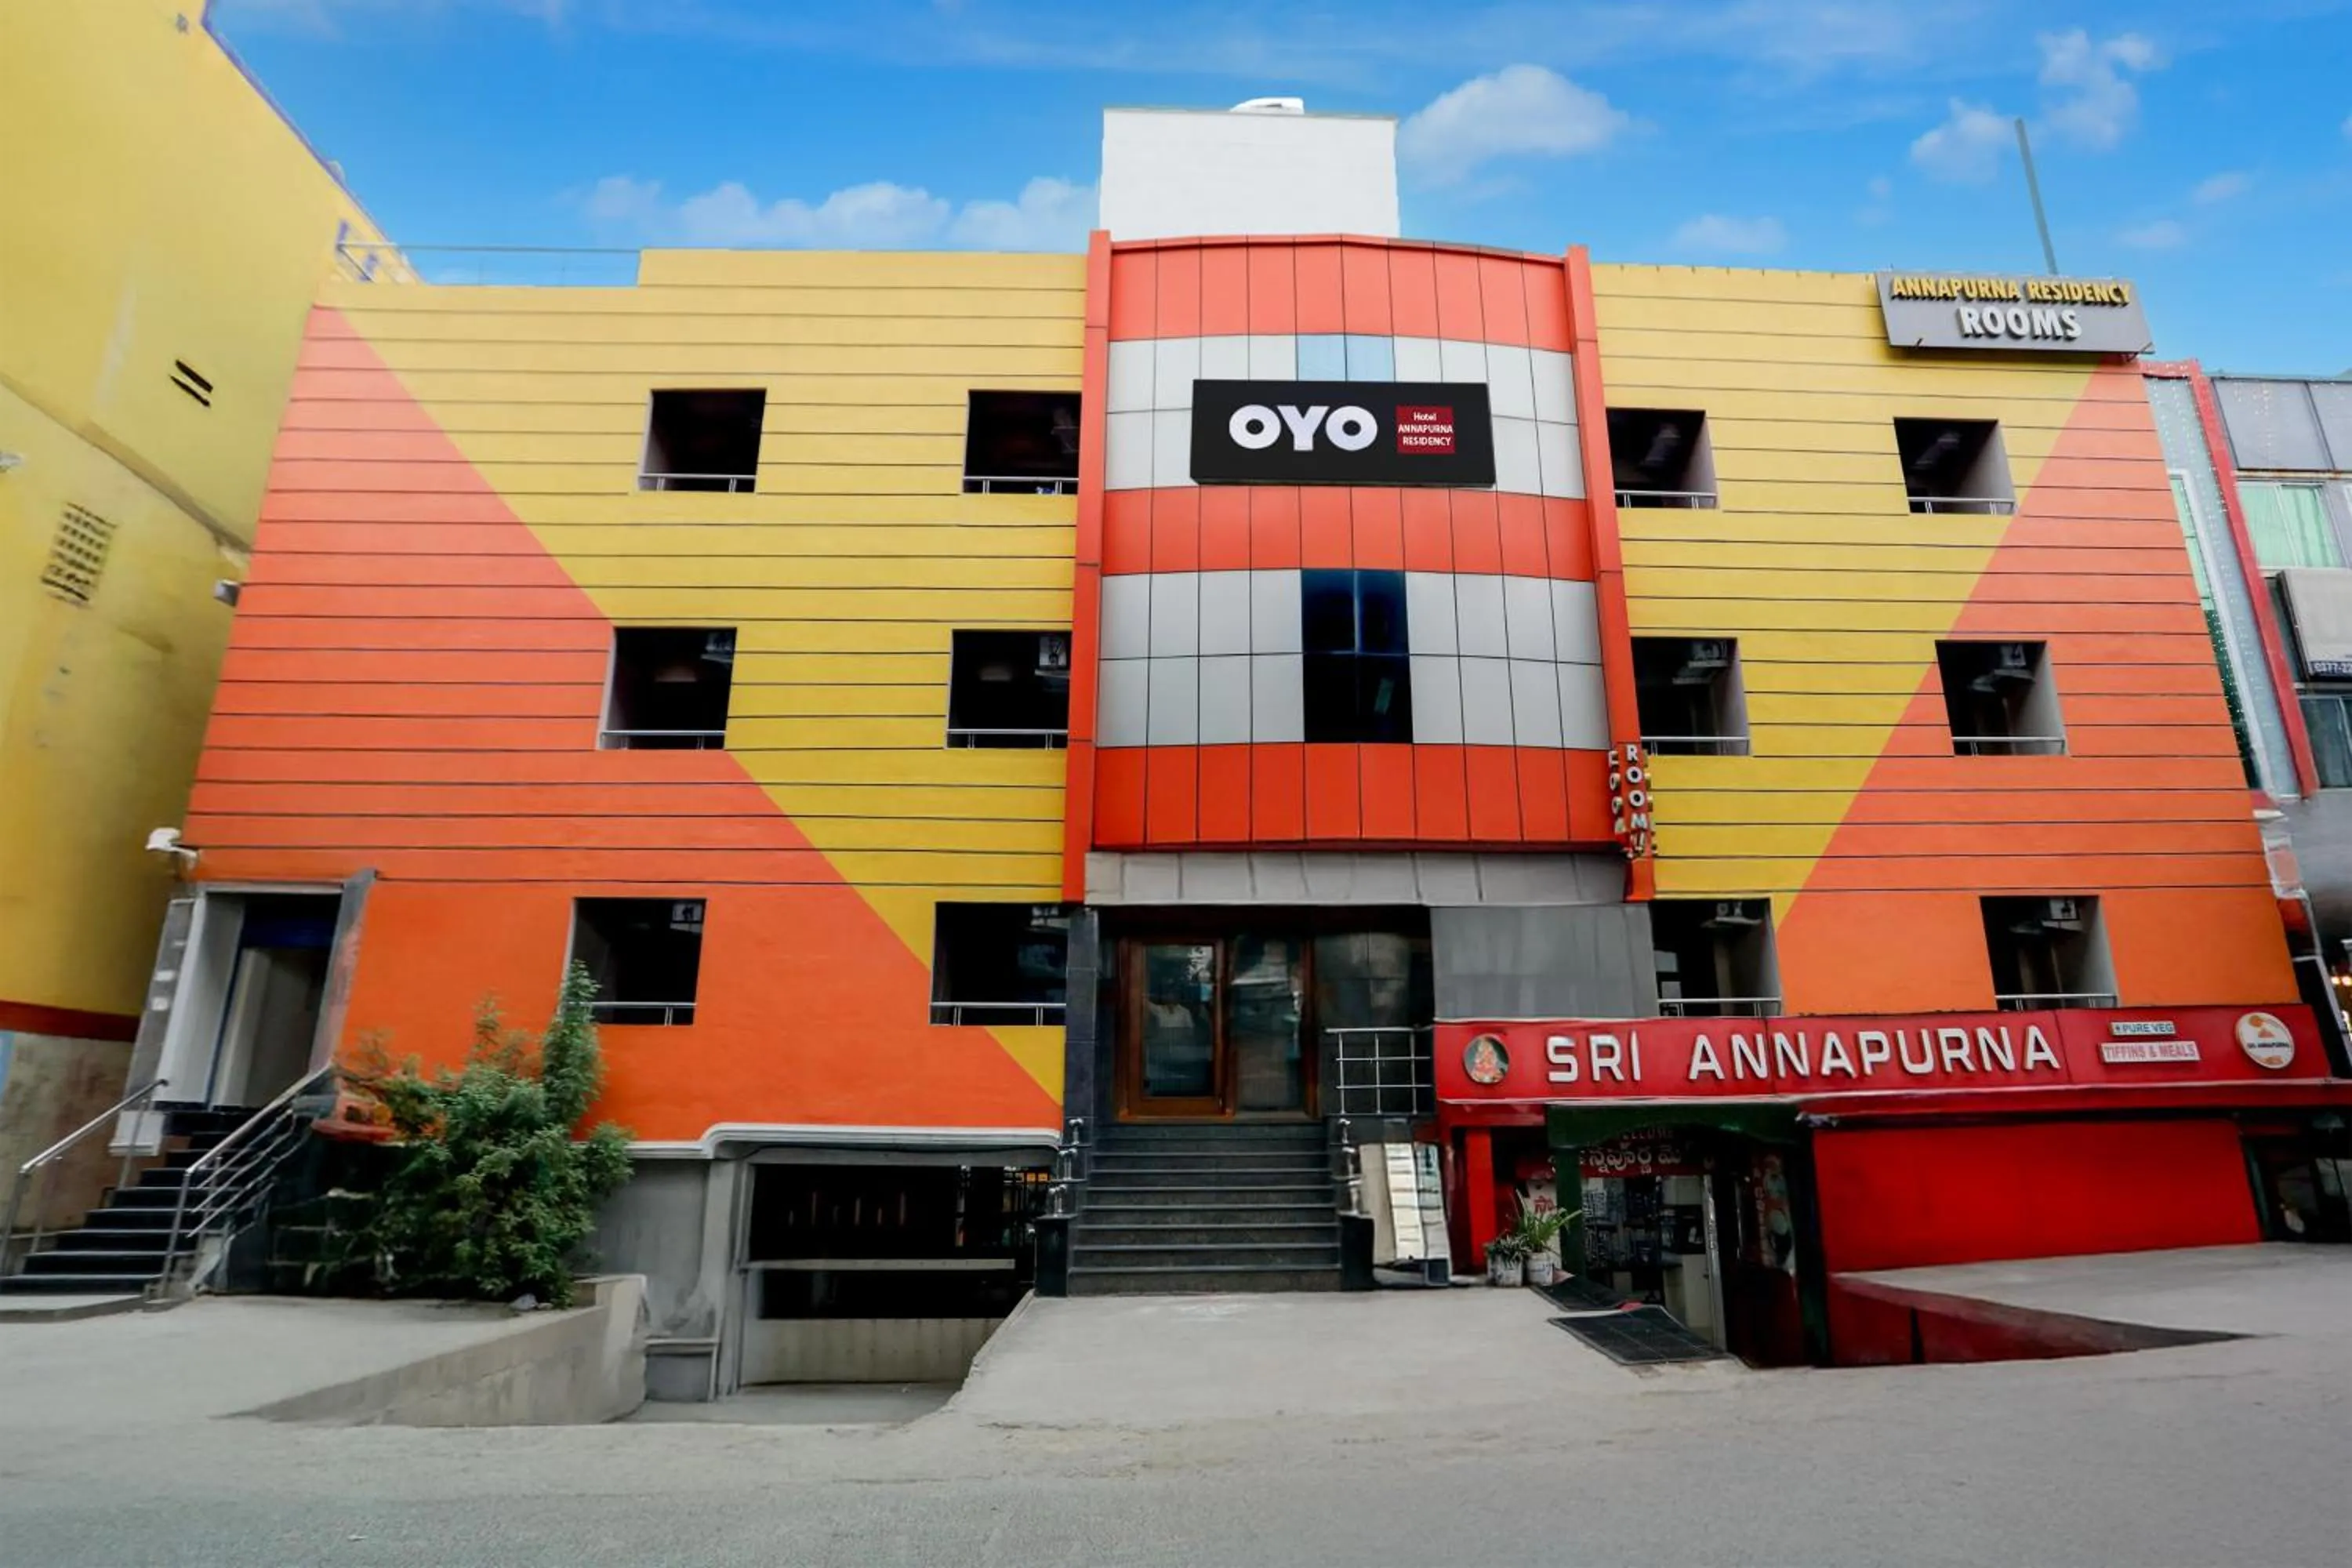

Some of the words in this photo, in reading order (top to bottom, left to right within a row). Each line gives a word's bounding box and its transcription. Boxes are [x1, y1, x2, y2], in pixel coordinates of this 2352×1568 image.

[1891, 276, 2020, 300] ANNAPURNA
[2027, 280, 2131, 304] RESIDENCY
[1960, 307, 2082, 339] ROOMS
[1414, 412, 1437, 422] Hotel
[1229, 404, 1378, 452] OYO
[1398, 424, 1454, 434] ANNAPURNA
[1403, 437, 1452, 447] RESIDENCY
[2122, 1023, 2151, 1033] PURE
[2152, 1023, 2174, 1033] VEG
[1546, 1030, 1642, 1083] SRI
[1688, 1024, 2061, 1081] ANNAPURNA
[2104, 1044, 2147, 1060] TIFFINS
[2159, 1043, 2197, 1058] MEALS
